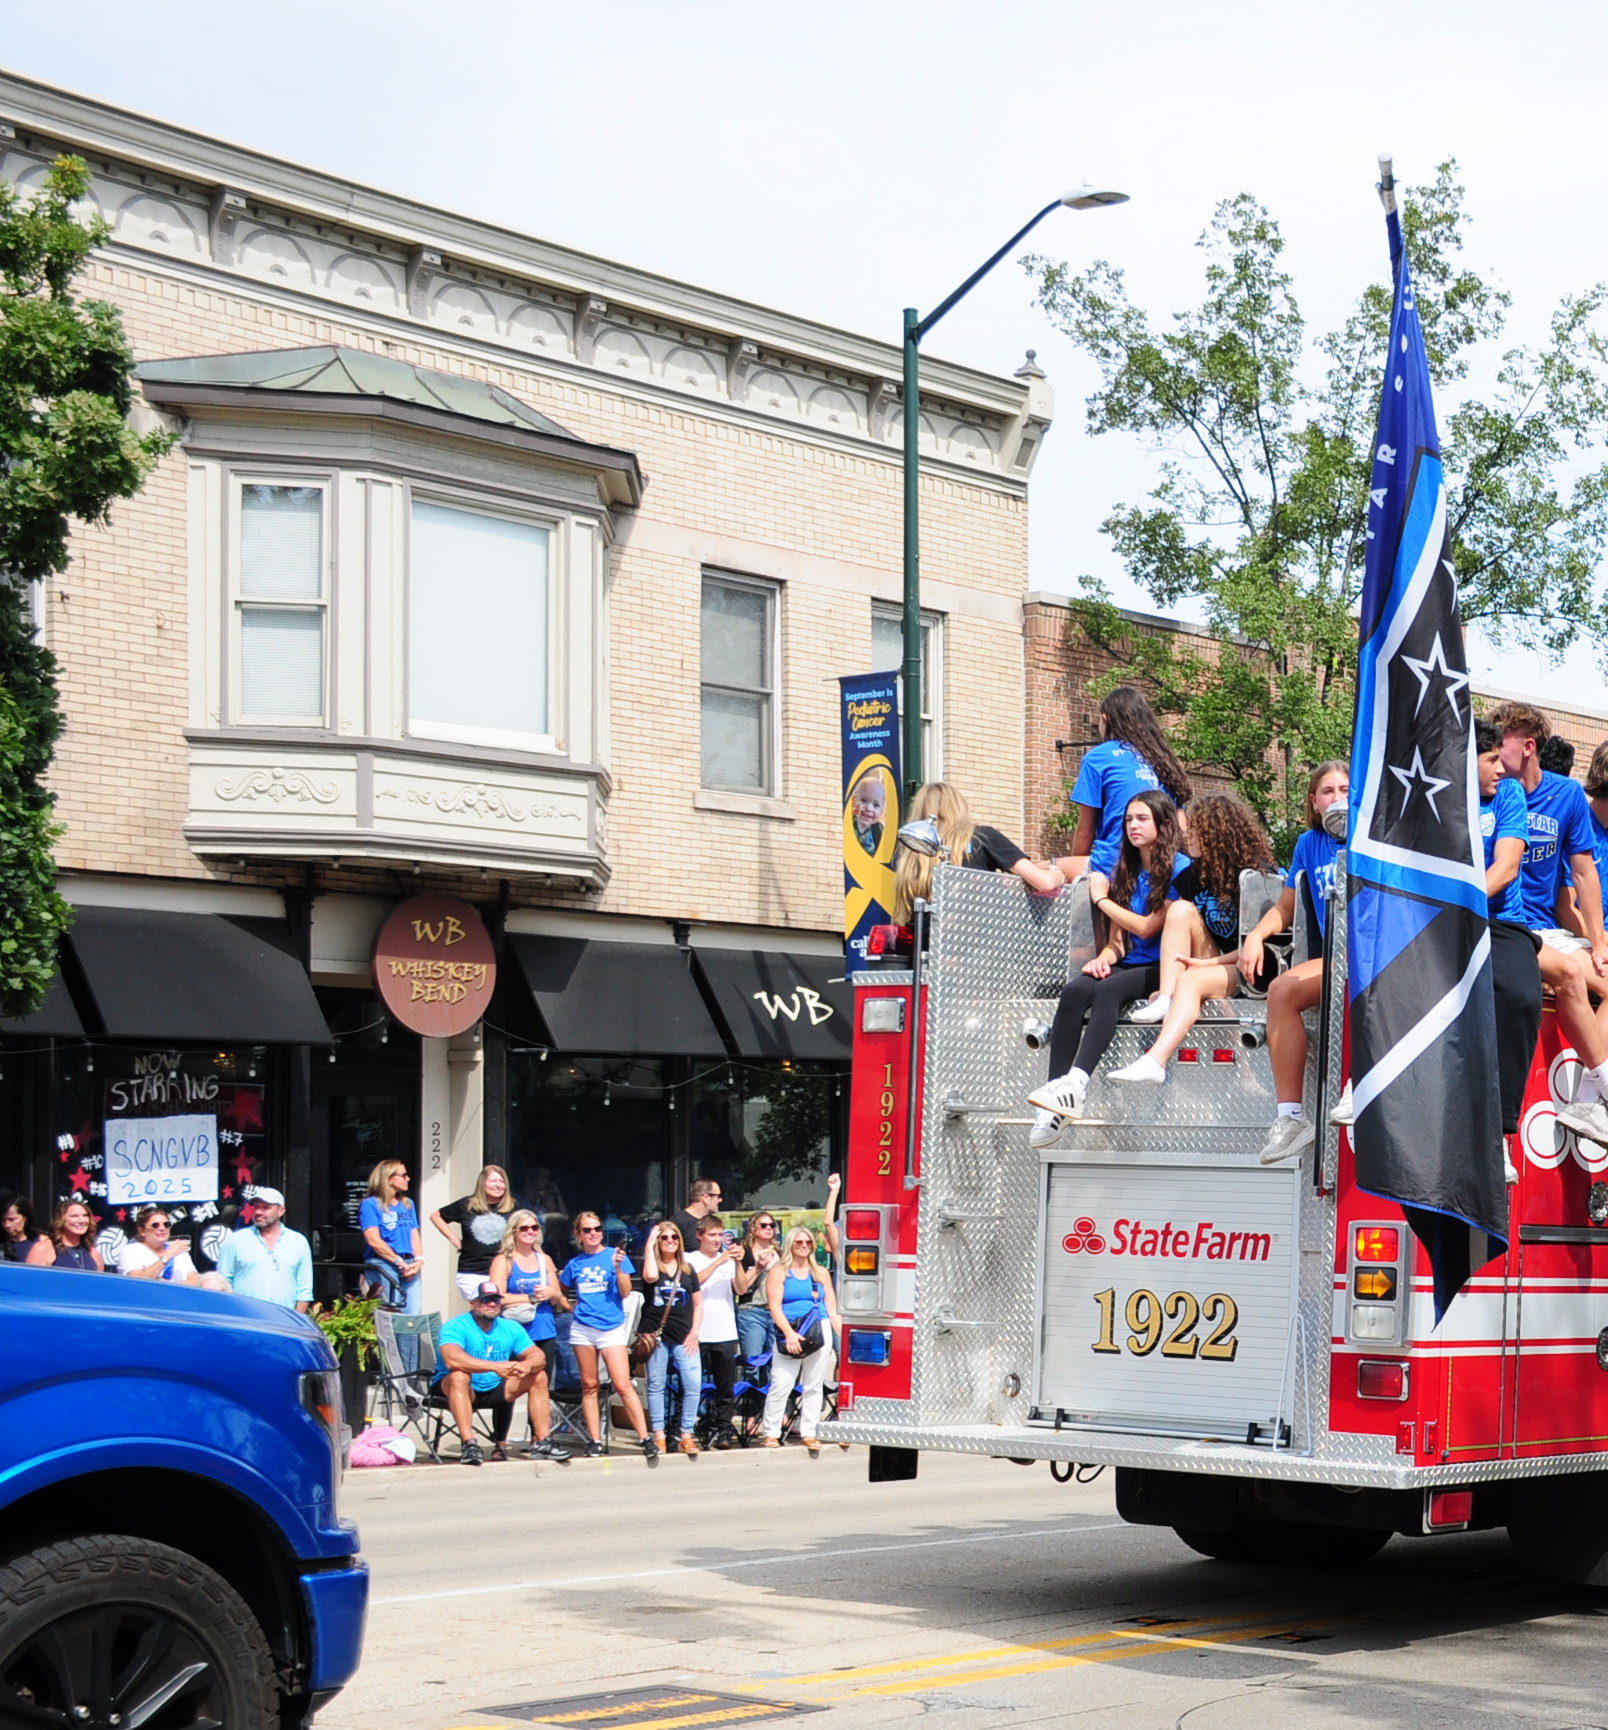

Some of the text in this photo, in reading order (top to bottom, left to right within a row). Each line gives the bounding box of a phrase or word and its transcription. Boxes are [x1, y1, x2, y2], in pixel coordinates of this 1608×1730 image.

[845, 687, 894, 702] September is
[847, 700, 892, 720] Pediatric
[849, 730, 891, 740] Awareness
[852, 716, 886, 731] Cancer
[857, 739, 883, 749] Month
[410, 915, 466, 946] WB
[388, 960, 487, 991] WHISKEY
[411, 980, 467, 1004] BEND
[753, 986, 834, 1026] WB
[134, 1053, 183, 1076] NOW
[877, 1062, 894, 1176] 1922
[219, 1128, 244, 1147] #7
[431, 1121, 441, 1170] 222
[113, 1134, 211, 1178] SCNGVB
[121, 1177, 192, 1198] 2025
[1091, 1287, 1239, 1362] 1922
